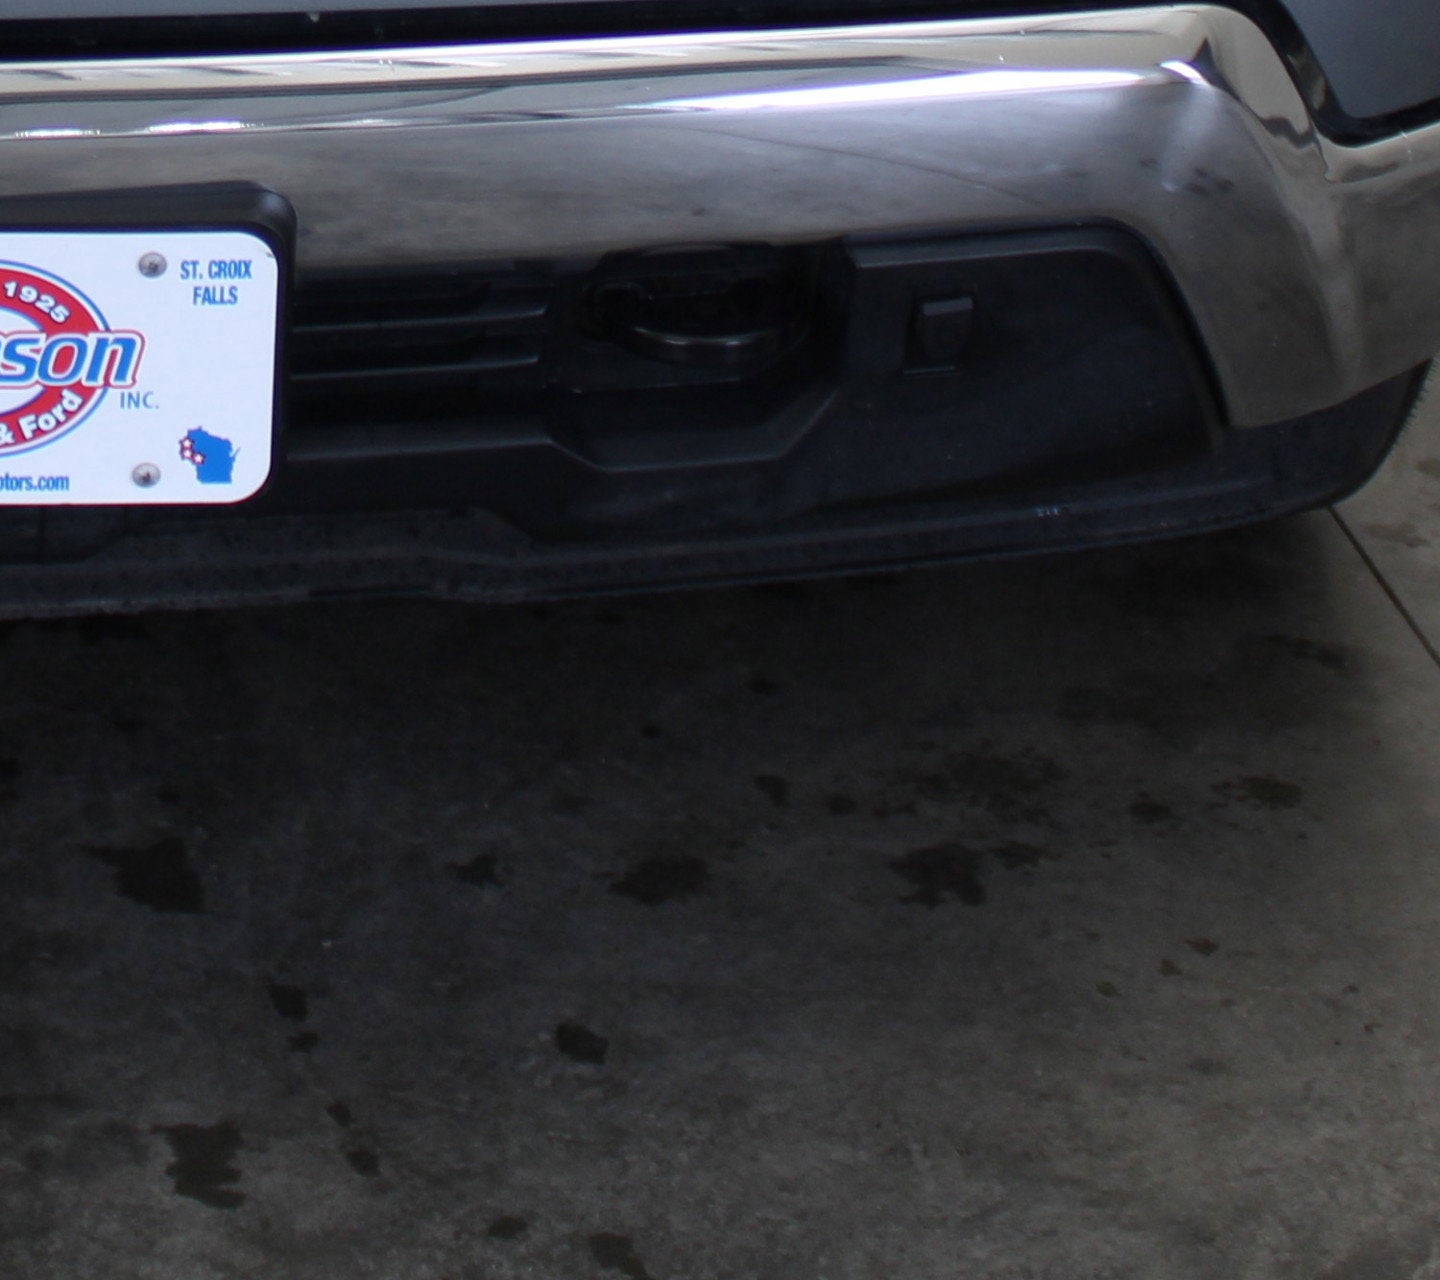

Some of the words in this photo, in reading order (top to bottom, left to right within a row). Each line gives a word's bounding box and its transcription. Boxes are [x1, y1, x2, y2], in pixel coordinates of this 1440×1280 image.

[180, 259, 203, 280] ST.
[208, 260, 252, 279] CROIX
[3, 280, 70, 324] 1925
[193, 286, 238, 306] FALLS
[120, 391, 159, 409] INC.
[18, 389, 83, 440] Ford
